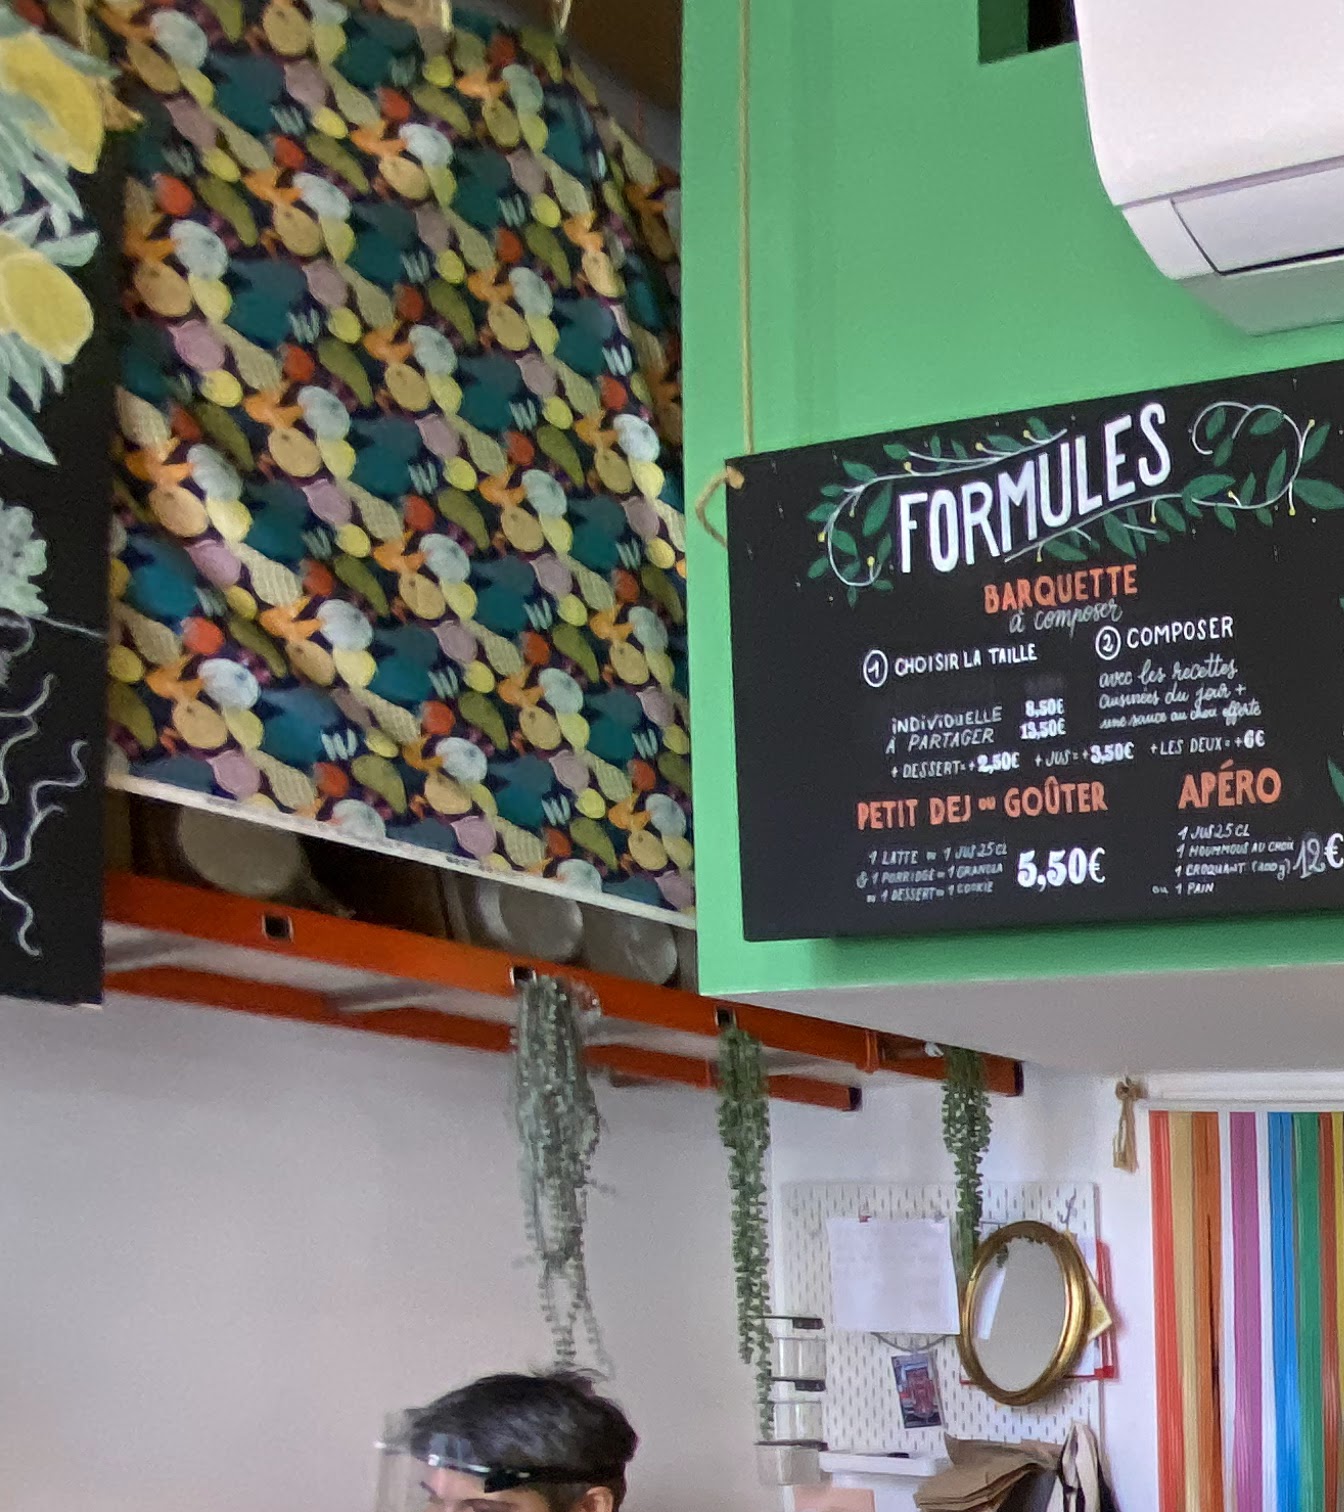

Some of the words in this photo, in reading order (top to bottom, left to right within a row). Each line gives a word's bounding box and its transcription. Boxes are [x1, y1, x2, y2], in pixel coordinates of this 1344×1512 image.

[899, 402, 1172, 574] FORMULES
[984, 564, 1138, 615] BARQUETTE
[1009, 608, 1025, 633] à
[1034, 598, 1123, 638] composer
[1126, 616, 1234, 649] COMPOSER
[894, 651, 960, 677] CHOISIR
[963, 649, 982, 668] LA
[988, 643, 1039, 665] TAILLE
[1099, 671, 1133, 688] avec
[1138, 659, 1166, 685] les
[1172, 652, 1238, 681] recettes
[908, 728, 995, 752] PARTAGER
[857, 799, 918, 830] PETIT
[929, 795, 972, 825] DEJ
[1003, 775, 1109, 818] GOÛTER
[1178, 758, 1283, 810] APÉRO
[1016, 847, 1107, 893] 5,50€
[1187, 882, 1215, 895] PAIN
